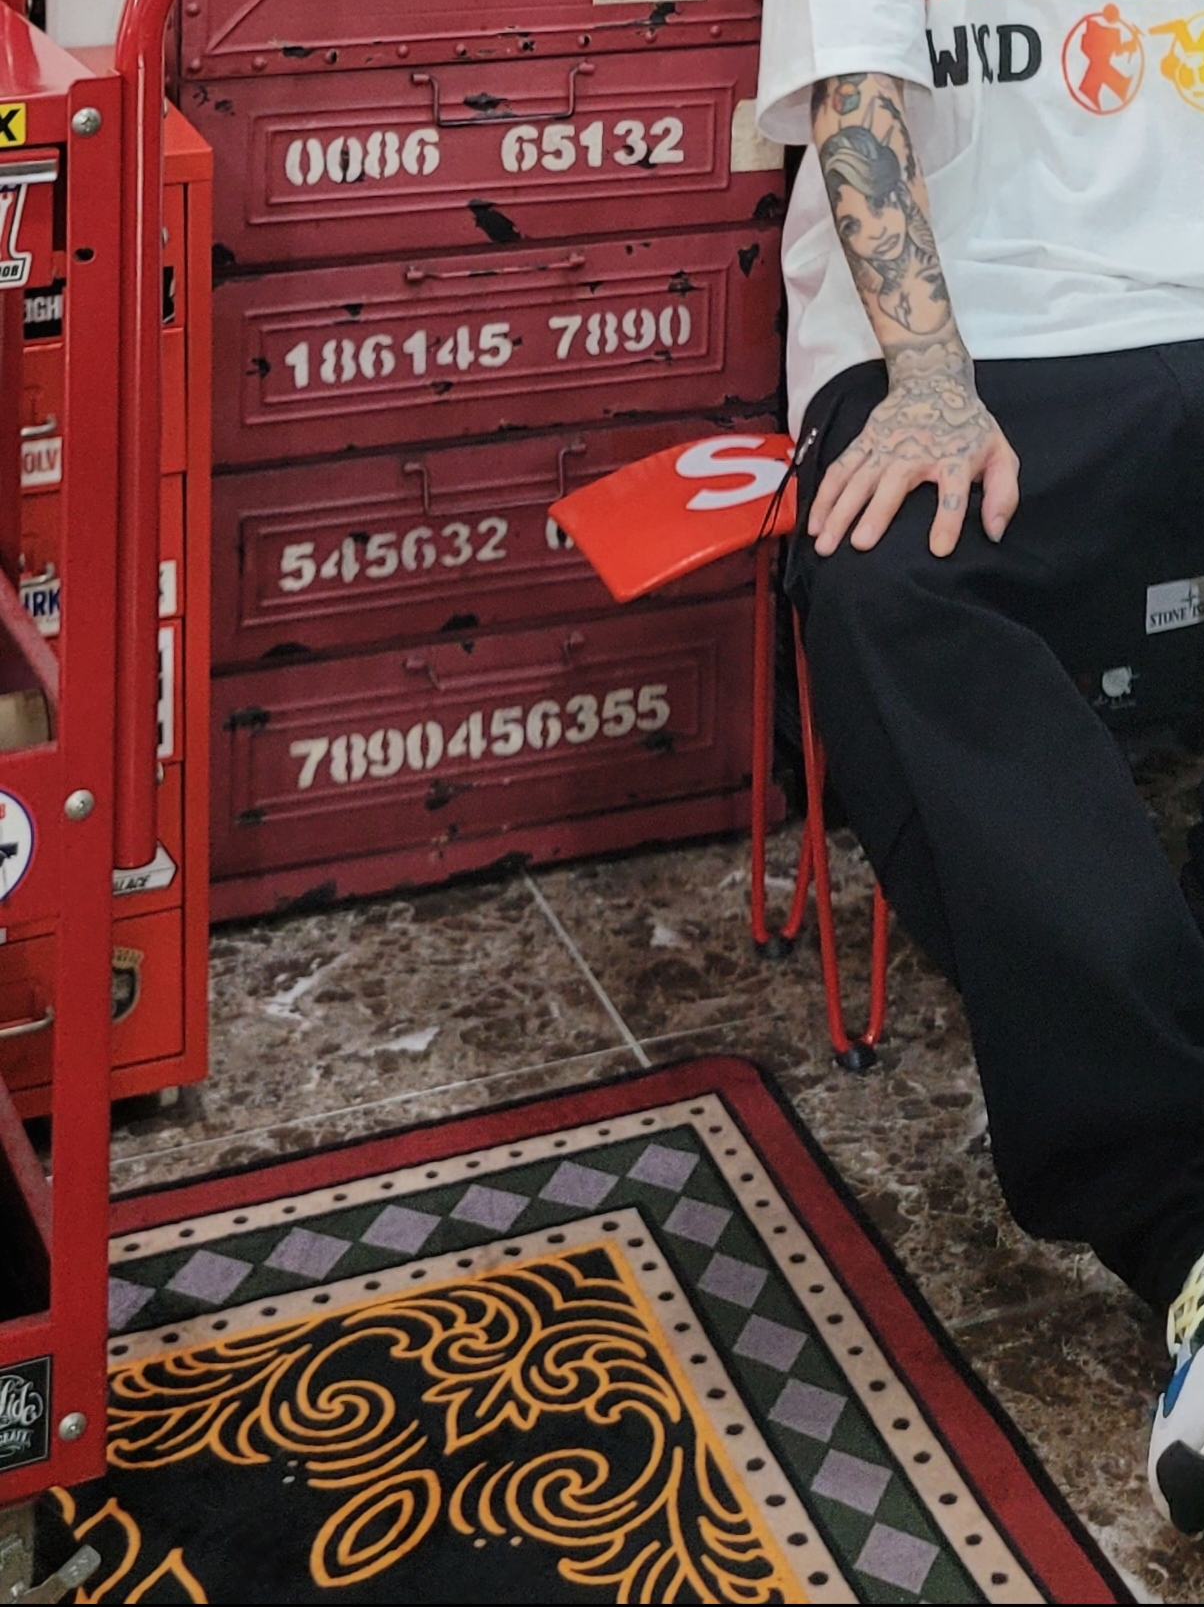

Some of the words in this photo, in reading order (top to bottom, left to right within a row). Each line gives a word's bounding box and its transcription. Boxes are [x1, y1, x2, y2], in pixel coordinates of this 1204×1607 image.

[285, 128, 440, 186] 0086
[501, 117, 685, 174] 65132
[285, 322, 513, 390] 186145
[549, 305, 692, 361] 7890
[280, 517, 508, 593] 545632
[1150, 607, 1188, 628] STONE
[290, 684, 671, 789] 7890456355
